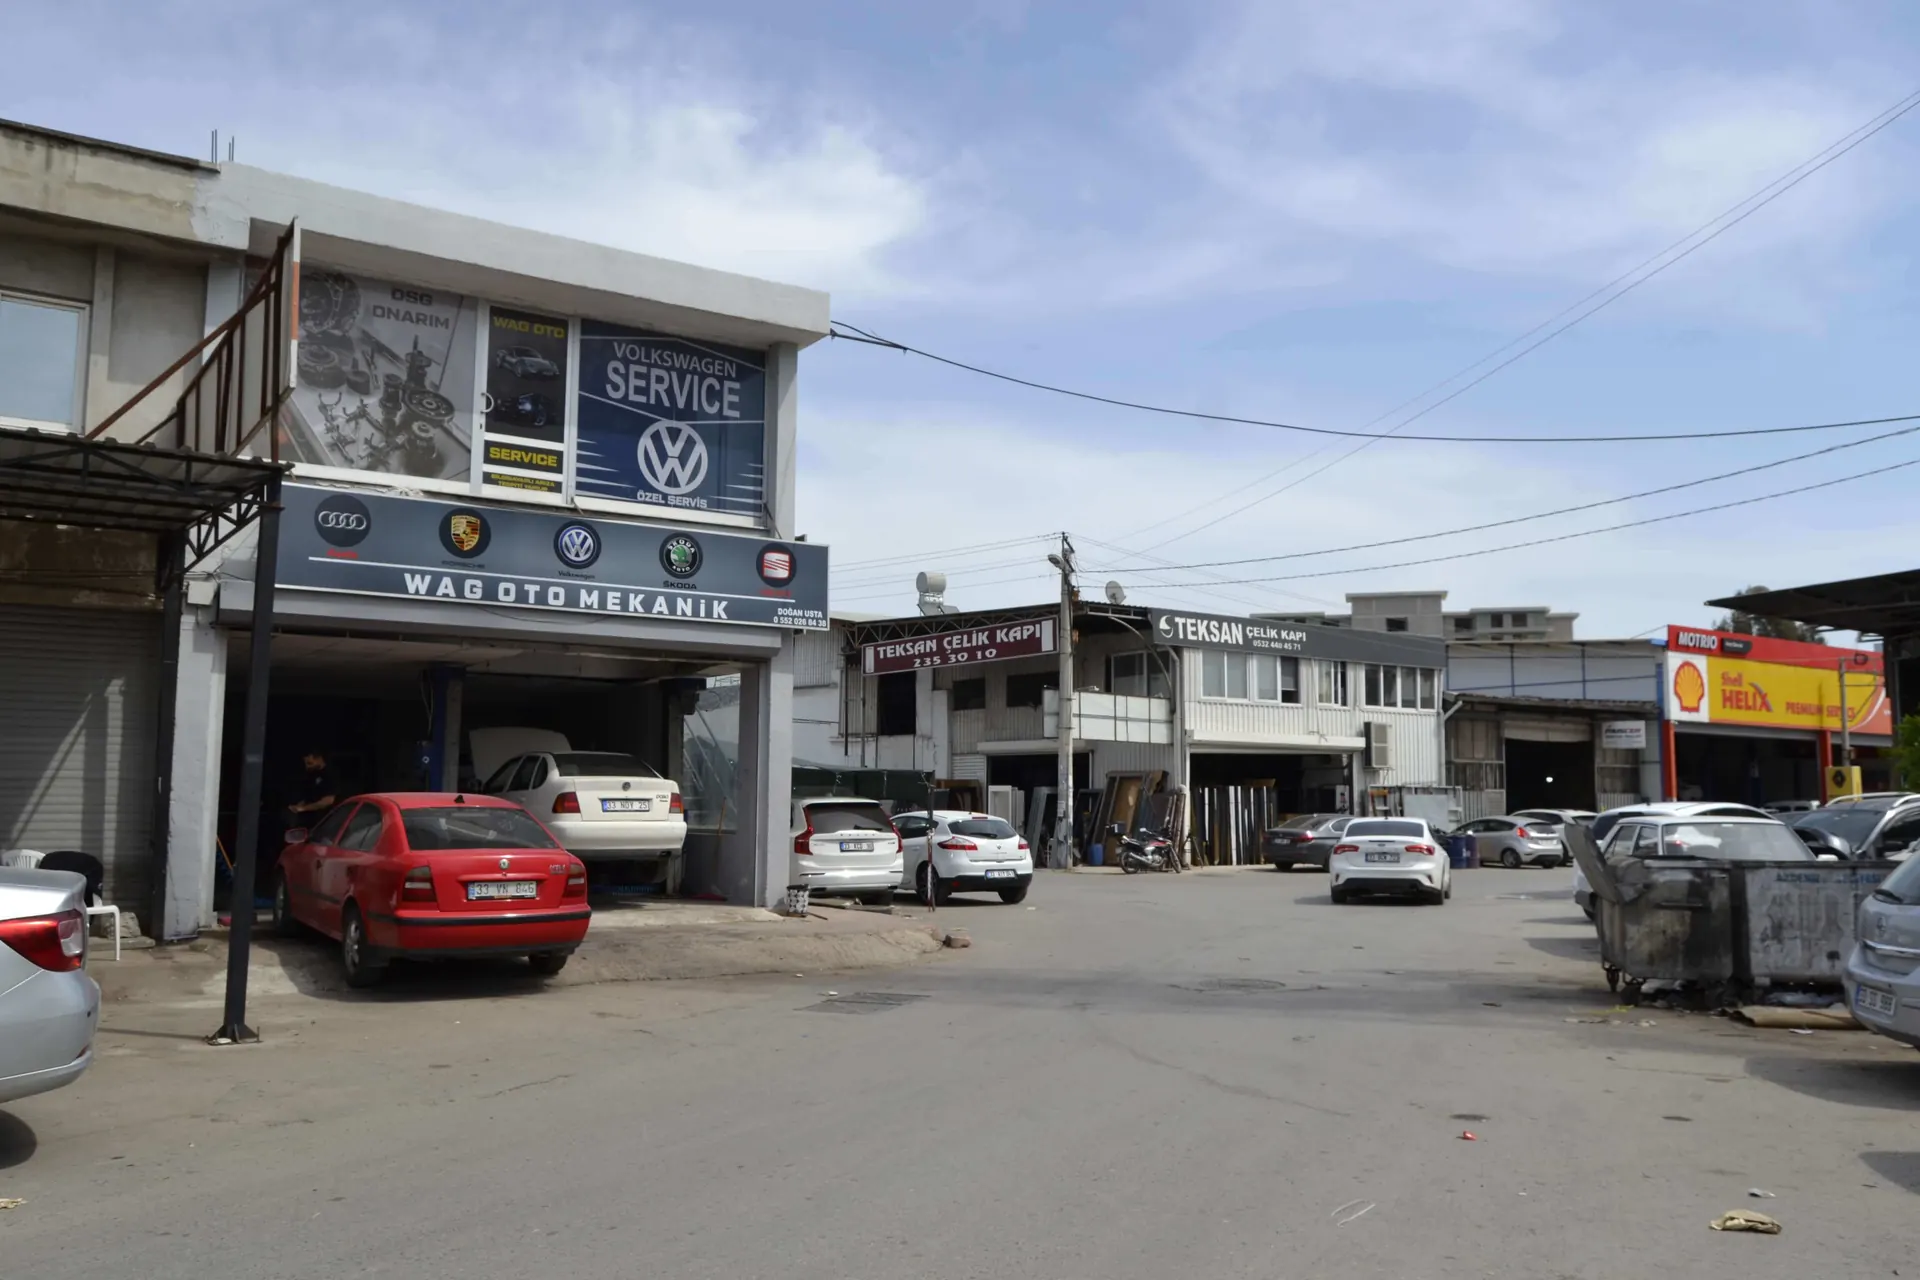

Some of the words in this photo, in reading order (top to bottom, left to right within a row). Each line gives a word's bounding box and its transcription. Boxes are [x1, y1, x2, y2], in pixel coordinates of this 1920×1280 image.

[493, 315, 530, 332] WAG
[533, 323, 565, 338] OTO
[613, 342, 736, 378] VOLKSWAGEN
[606, 360, 741, 418] SERVICE
[489, 447, 558, 467] SERVICE
[637, 489, 665, 504] ÖZEL
[404, 573, 483, 600] WAG
[498, 582, 566, 606] OTO
[804, 610, 823, 618] USTA
[1174, 617, 1243, 645] TEKSAN
[1246, 626, 1278, 639] ÇELİK
[1280, 629, 1306, 642] KAPI
[1677, 631, 1718, 650] MOTRIO
[877, 639, 937, 659] TEKSAN
[943, 631, 989, 654] ÇELİK
[996, 624, 1041, 643] KAPI
[1252, 639, 1269, 648] 0532
[913, 656, 941, 668] 235
[948, 652, 968, 663] 30
[976, 648, 997, 660] 10
[1722, 688, 1771, 712] HELIX
[607, 801, 616, 809] 33
[639, 801, 647, 809] 25
[476, 883, 489, 895] 33
[496, 883, 508, 894] VN
